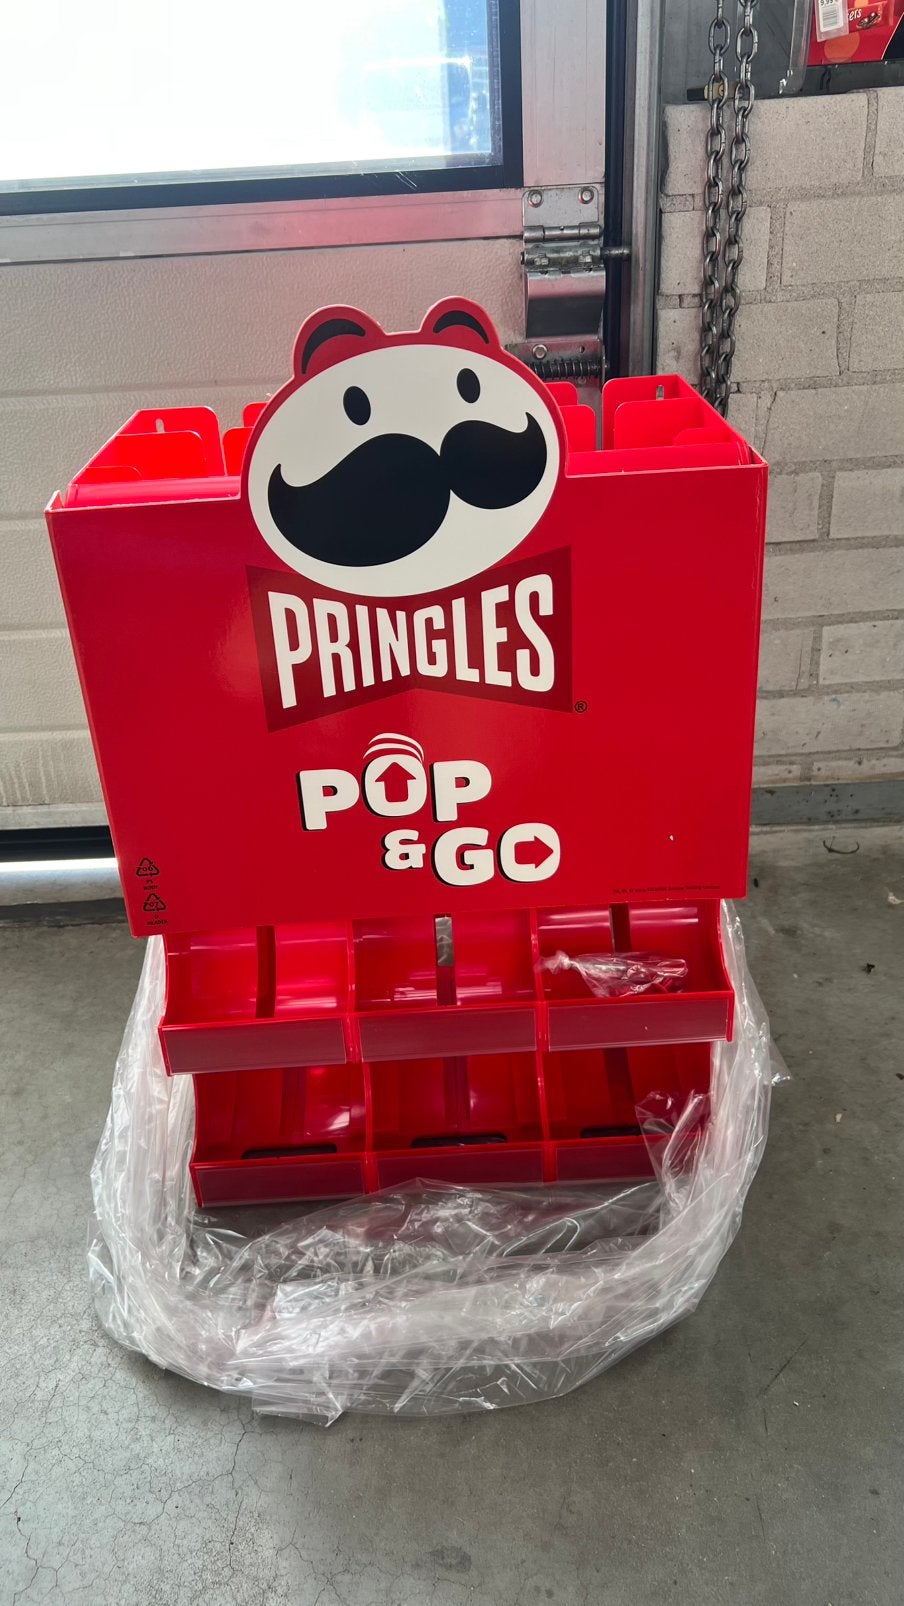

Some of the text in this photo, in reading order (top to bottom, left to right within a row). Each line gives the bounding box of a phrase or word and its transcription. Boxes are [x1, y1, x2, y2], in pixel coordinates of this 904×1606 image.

[847, 8, 862, 21] ers
[268, 574, 555, 709] PRINGLES
[296, 753, 492, 831] POP
